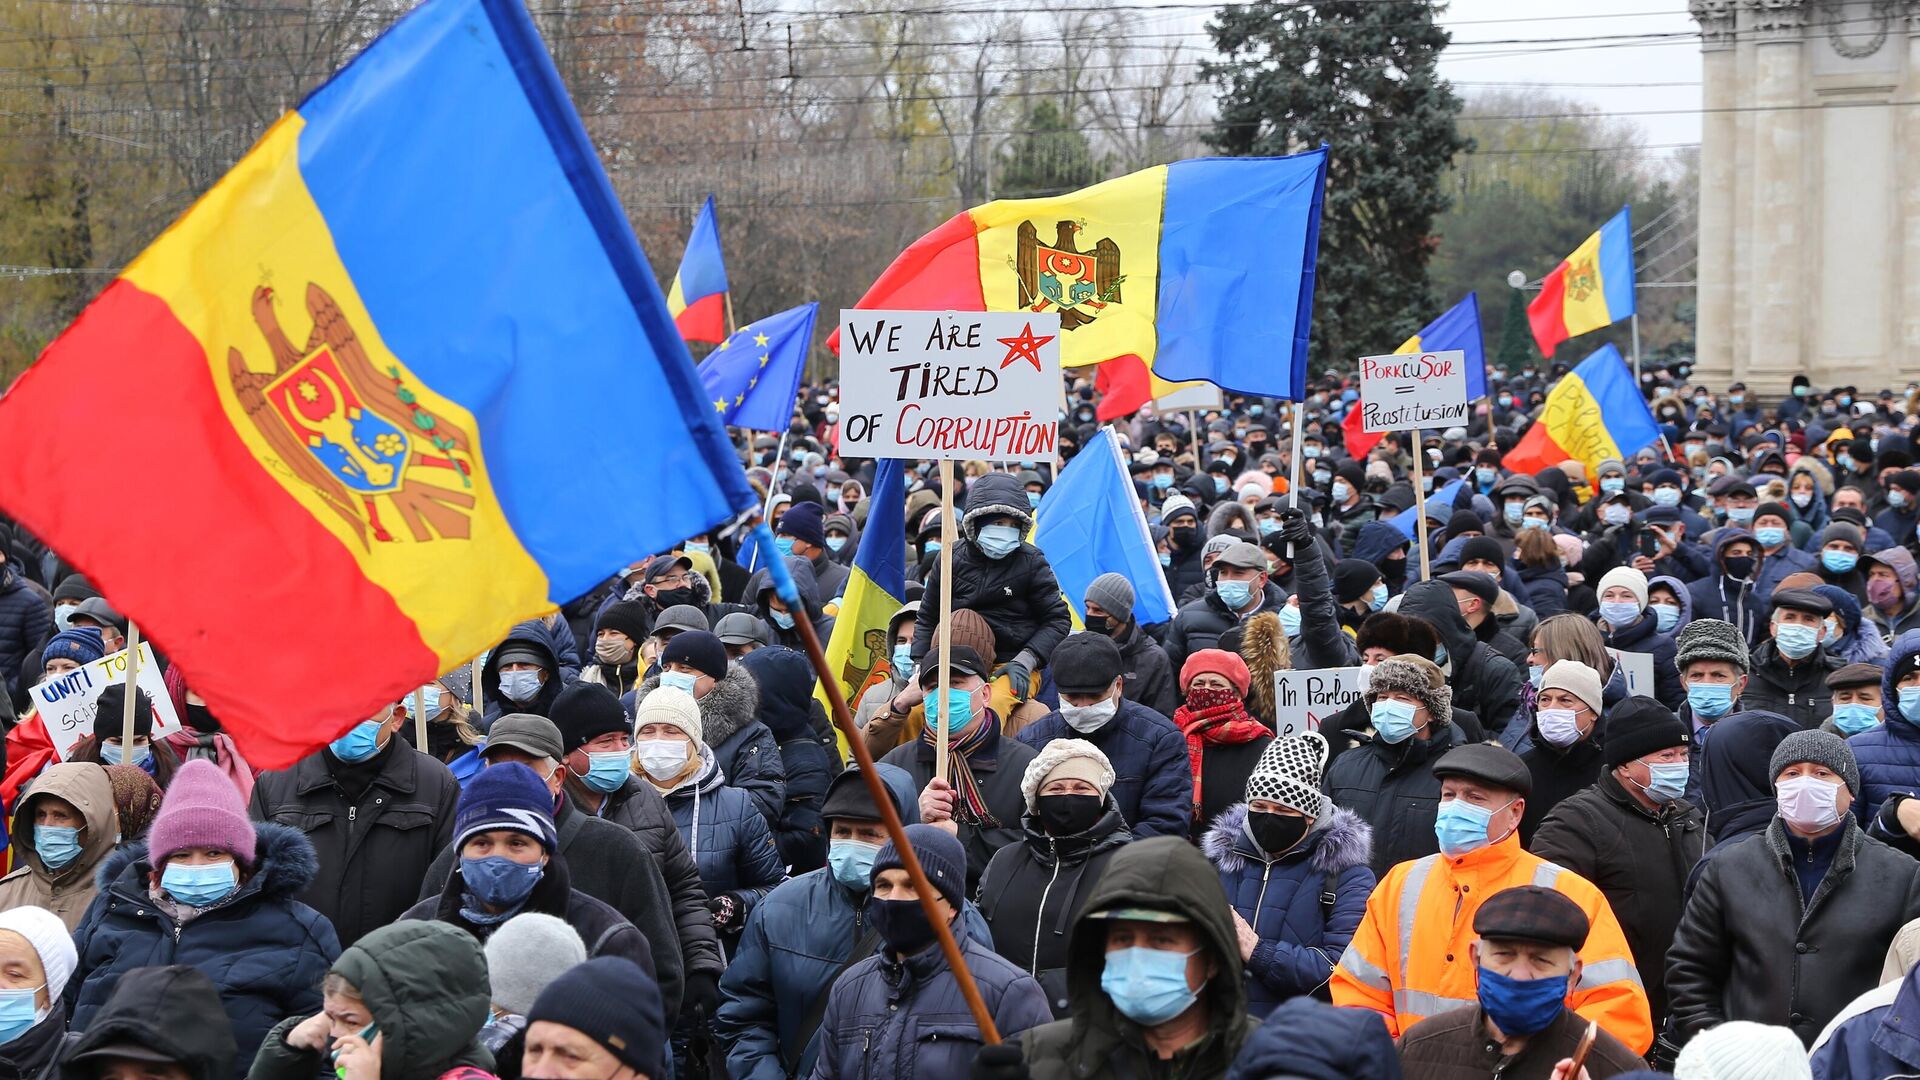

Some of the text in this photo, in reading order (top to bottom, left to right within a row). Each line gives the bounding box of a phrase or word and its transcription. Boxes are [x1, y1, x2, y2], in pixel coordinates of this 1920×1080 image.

[849, 318, 981, 354] WE ARE
[846, 404, 1056, 456] OF CORRUPTION
[99, 647, 145, 679] TOI
[1279, 677, 1297, 706] În
